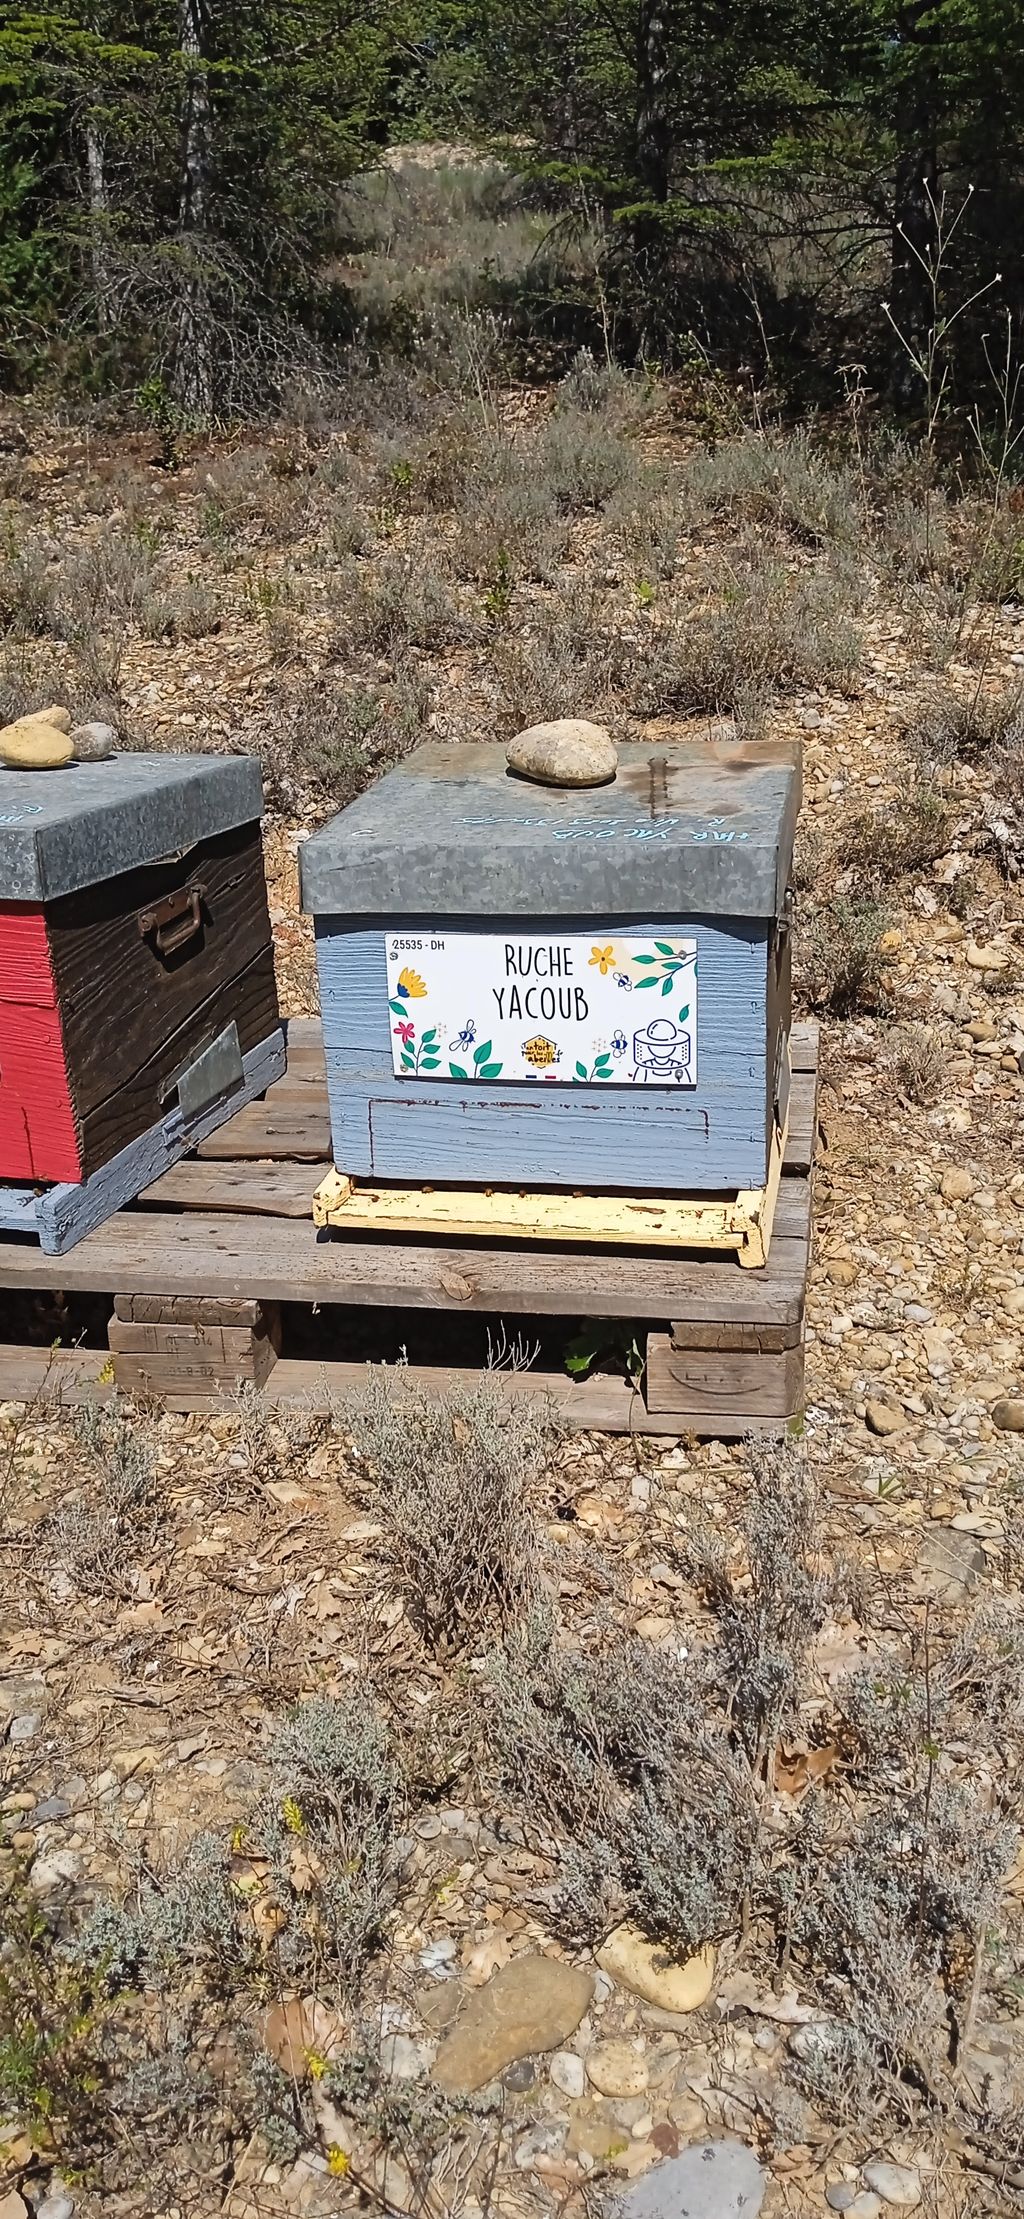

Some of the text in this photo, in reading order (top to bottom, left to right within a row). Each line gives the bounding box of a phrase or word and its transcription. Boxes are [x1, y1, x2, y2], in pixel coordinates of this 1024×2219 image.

[392, 939, 423, 950] 25535
[430, 940, 446, 951] DH
[504, 943, 574, 977] RUCHE
[492, 984, 589, 1021] YACOUB
